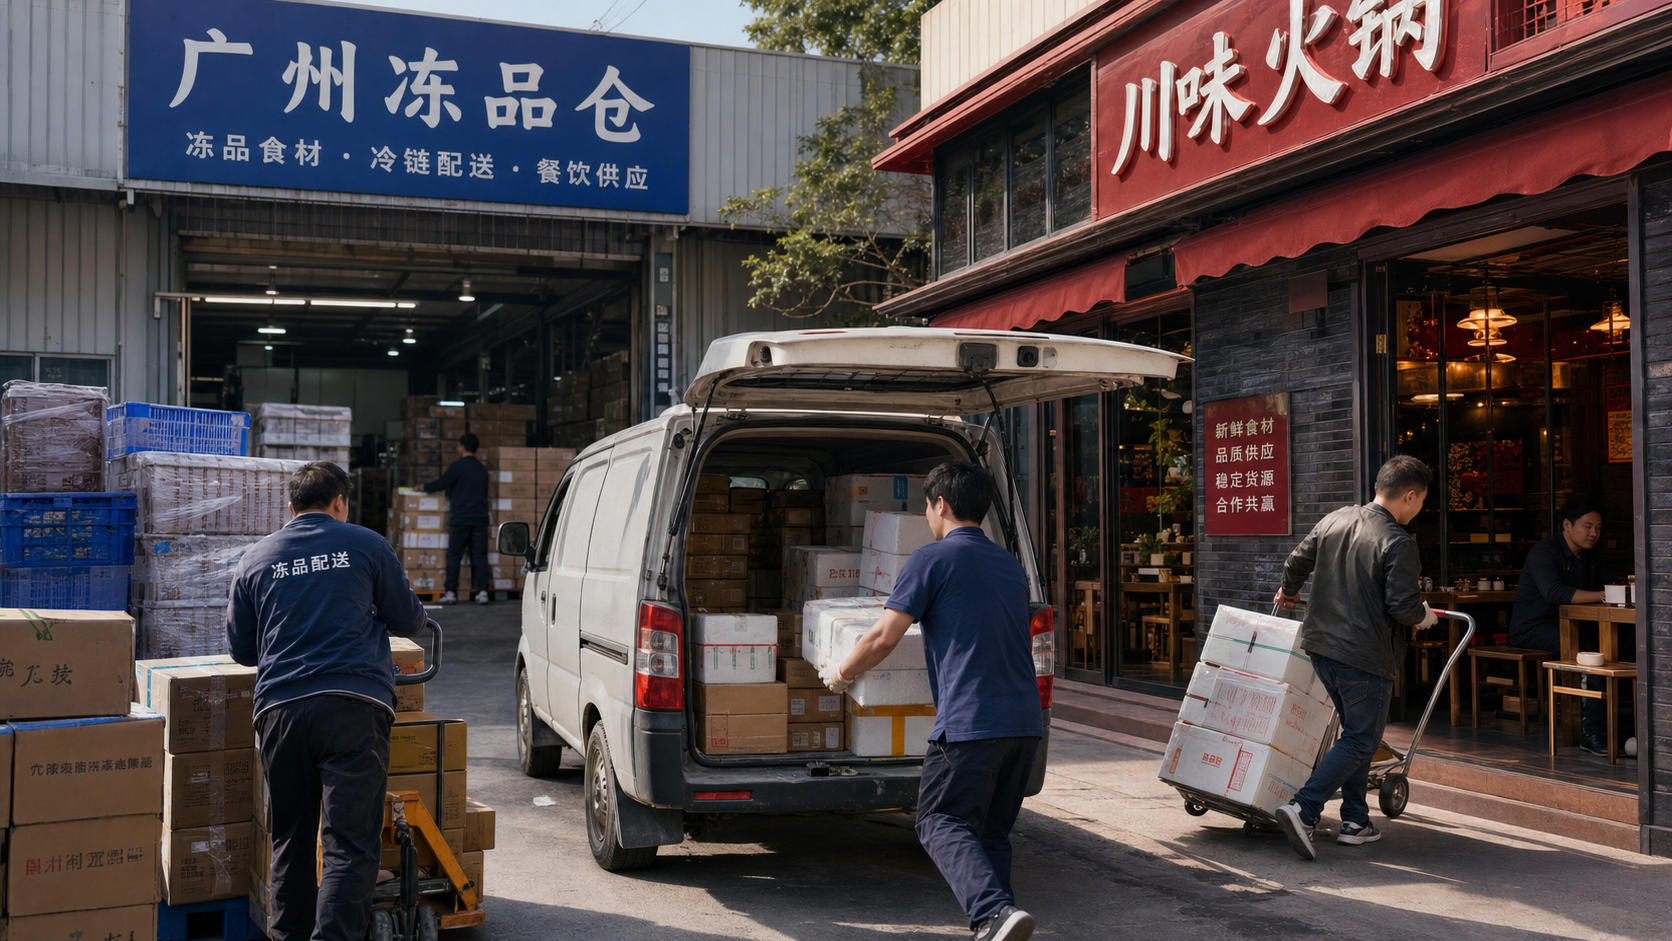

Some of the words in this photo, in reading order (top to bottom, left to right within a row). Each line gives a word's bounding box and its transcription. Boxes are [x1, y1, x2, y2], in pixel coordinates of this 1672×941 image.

[169, 27, 655, 143] 广州冻品仓
[186, 131, 321, 166] 冻品食材
[370, 145, 494, 179] 冷链配送
[537, 159, 649, 191] 餐饮供应
[1215, 417, 1275, 439] 新鲜食材
[1215, 443, 1275, 463] 品质供应
[1215, 469, 1275, 490] 稳定货源
[1215, 494, 1275, 514] 合作共赢
[271, 551, 351, 579] 冻品配送
